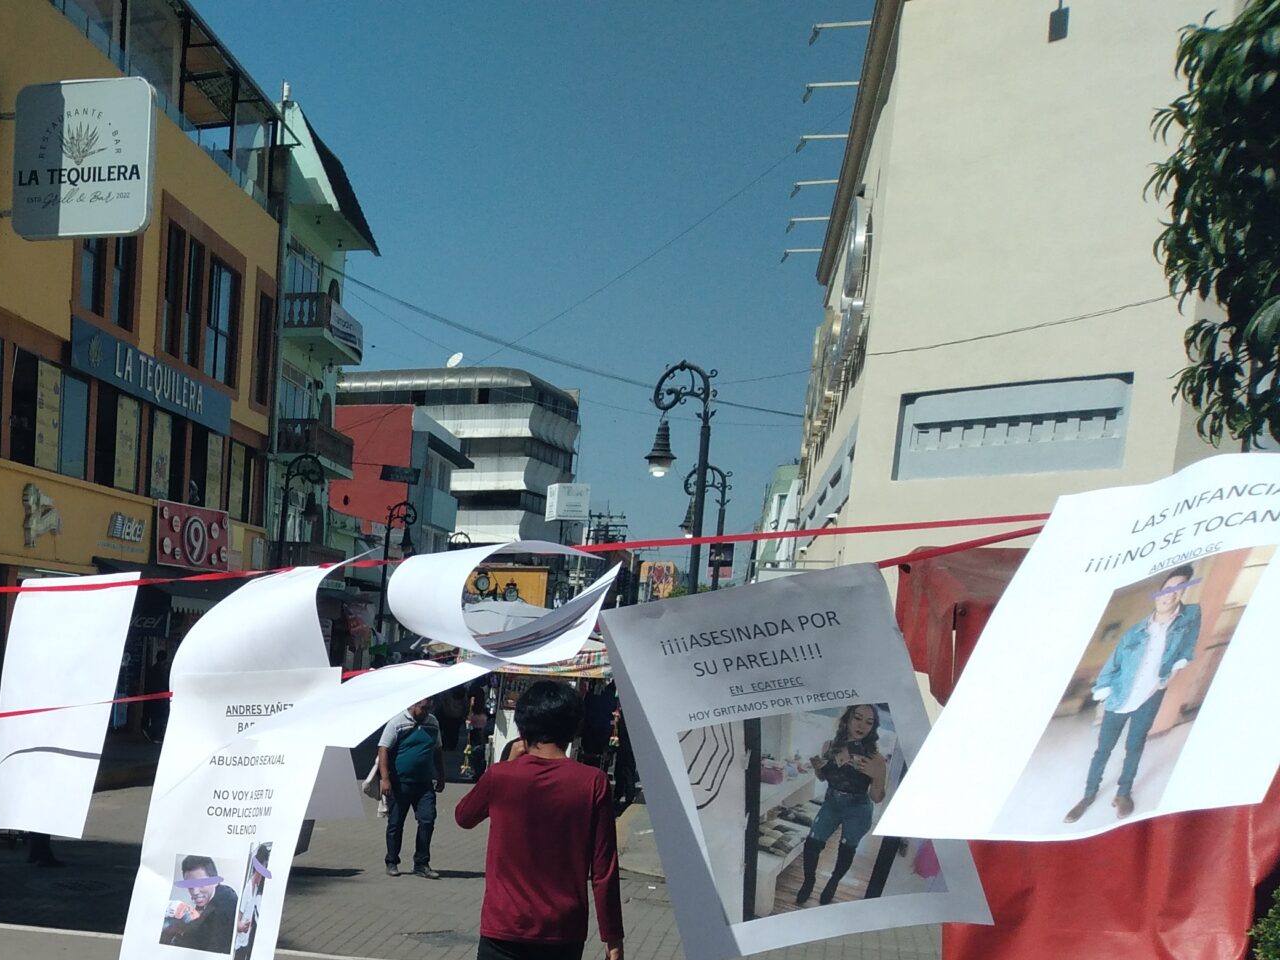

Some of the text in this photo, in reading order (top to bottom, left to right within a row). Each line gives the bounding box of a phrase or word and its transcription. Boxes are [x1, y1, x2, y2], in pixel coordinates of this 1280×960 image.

[38, 107, 122, 160] RESTAURANTE BAR
[18, 163, 141, 187] LA TEQUILERA
[114, 342, 204, 416] LA TEQUILERA
[1131, 507, 1170, 535] LAS
[190, 521, 204, 561] 9
[1159, 526, 1187, 551] SE
[1148, 541, 1224, 575] ANTONIO GC
[797, 610, 841, 632] POR
[693, 642, 824, 678] SU PAREJA!!!!
[729, 676, 804, 696] EN ECATEPEC
[225, 704, 262, 717] ANDRES
[688, 688, 860, 722] HOY GRITAMOS POR TI PRECIOSA
[209, 754, 285, 767] ABUSADOR SEXUAL
[213, 789, 230, 800] NO
[232, 790, 249, 801] VOY
[265, 788, 274, 799] TU
[206, 805, 272, 818] COMPLICE CON MI
[226, 824, 256, 835] SILENCIO
